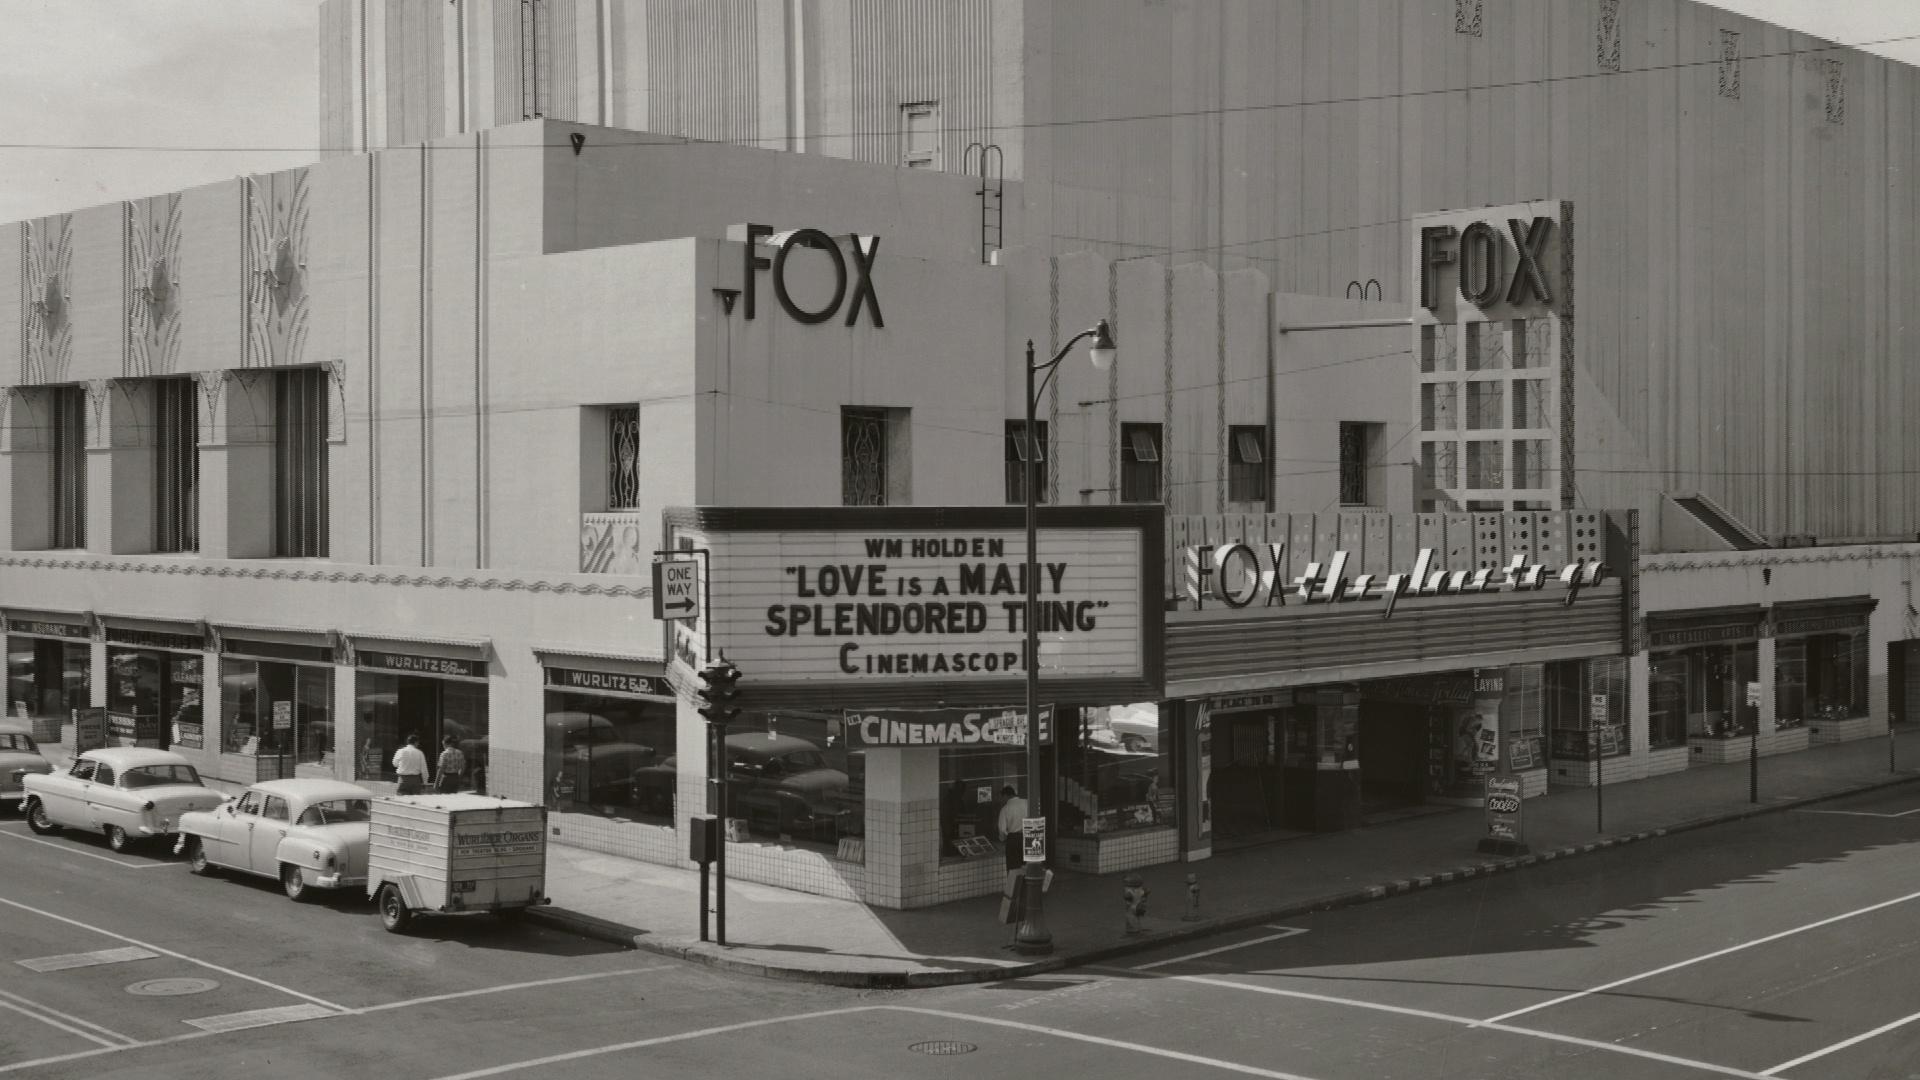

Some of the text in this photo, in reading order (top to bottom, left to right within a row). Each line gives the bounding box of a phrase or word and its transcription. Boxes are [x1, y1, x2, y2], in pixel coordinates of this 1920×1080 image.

[1421, 216, 1553, 311] FOX
[744, 222, 885, 328] FOX
[864, 538, 1004, 558] WM HOLDEN
[667, 567, 691, 582] ONE
[1188, 543, 1286, 611] FOX
[1502, 554, 1555, 592] to
[1558, 561, 1613, 607] go
[666, 582, 692, 597] WAY
[897, 576, 923, 597] IS
[932, 576, 950, 596] A
[764, 601, 987, 637] SPLENDORED
[385, 655, 458, 675] WURLITZER
[572, 672, 649, 690] WURLITZER
[1474, 677, 1504, 692] LAYING
[860, 711, 1050, 744] CINEMASCE
[503, 830, 540, 844] ORGANS
